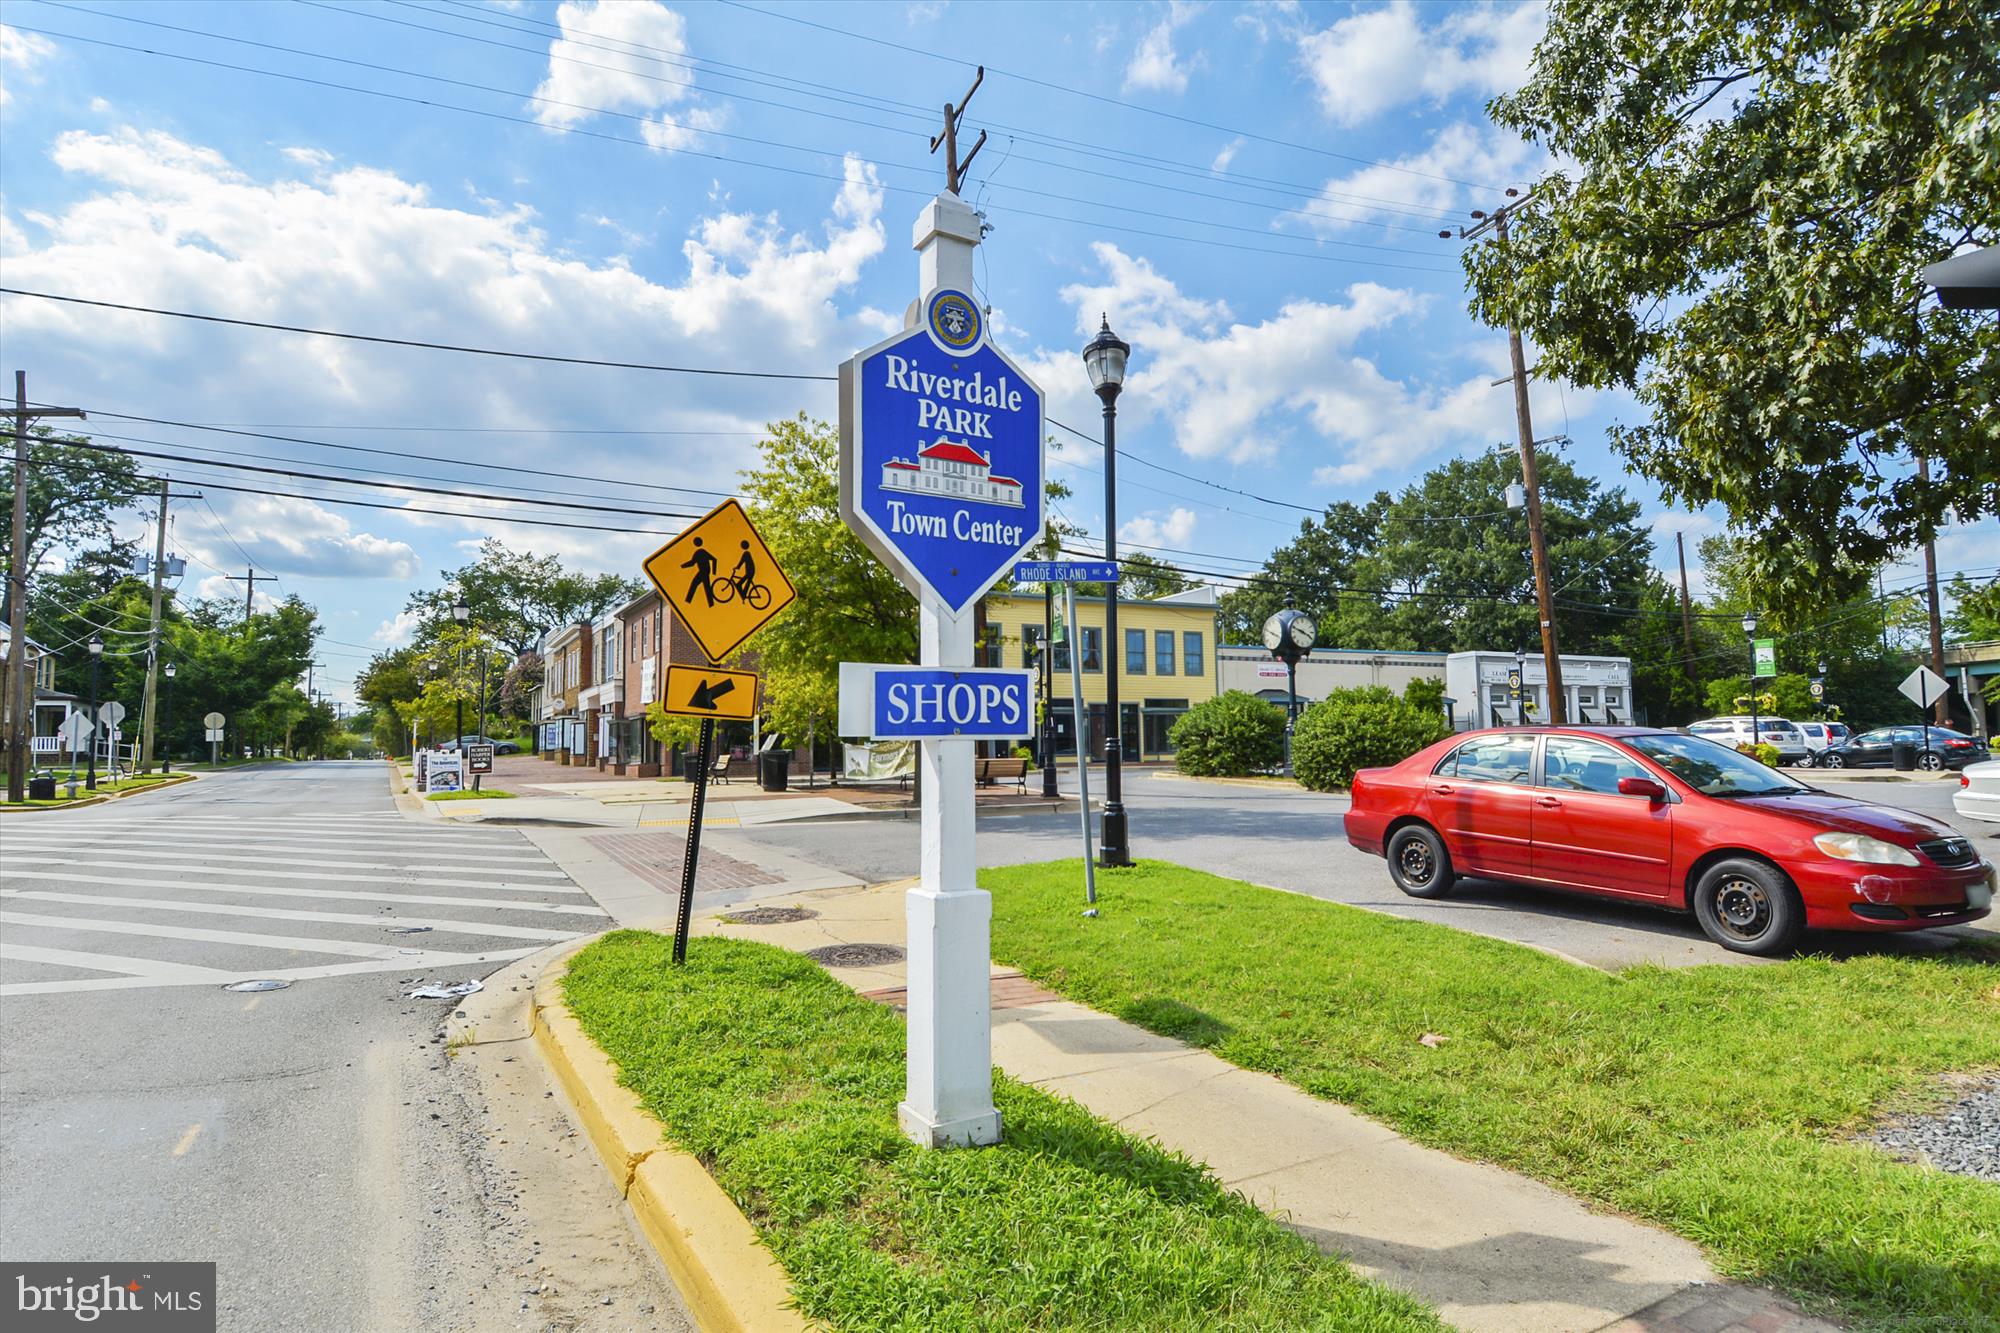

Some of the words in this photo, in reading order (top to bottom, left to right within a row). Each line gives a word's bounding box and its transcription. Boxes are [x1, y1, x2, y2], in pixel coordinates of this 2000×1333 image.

[885, 354, 1022, 412] Riverdale
[917, 398, 993, 439] PARK
[886, 500, 947, 538] Town
[953, 509, 1023, 546] Center
[1021, 568, 1051, 580] RHODE
[1055, 567, 1087, 580] ISLAND
[887, 683, 1021, 724] SHOPS
